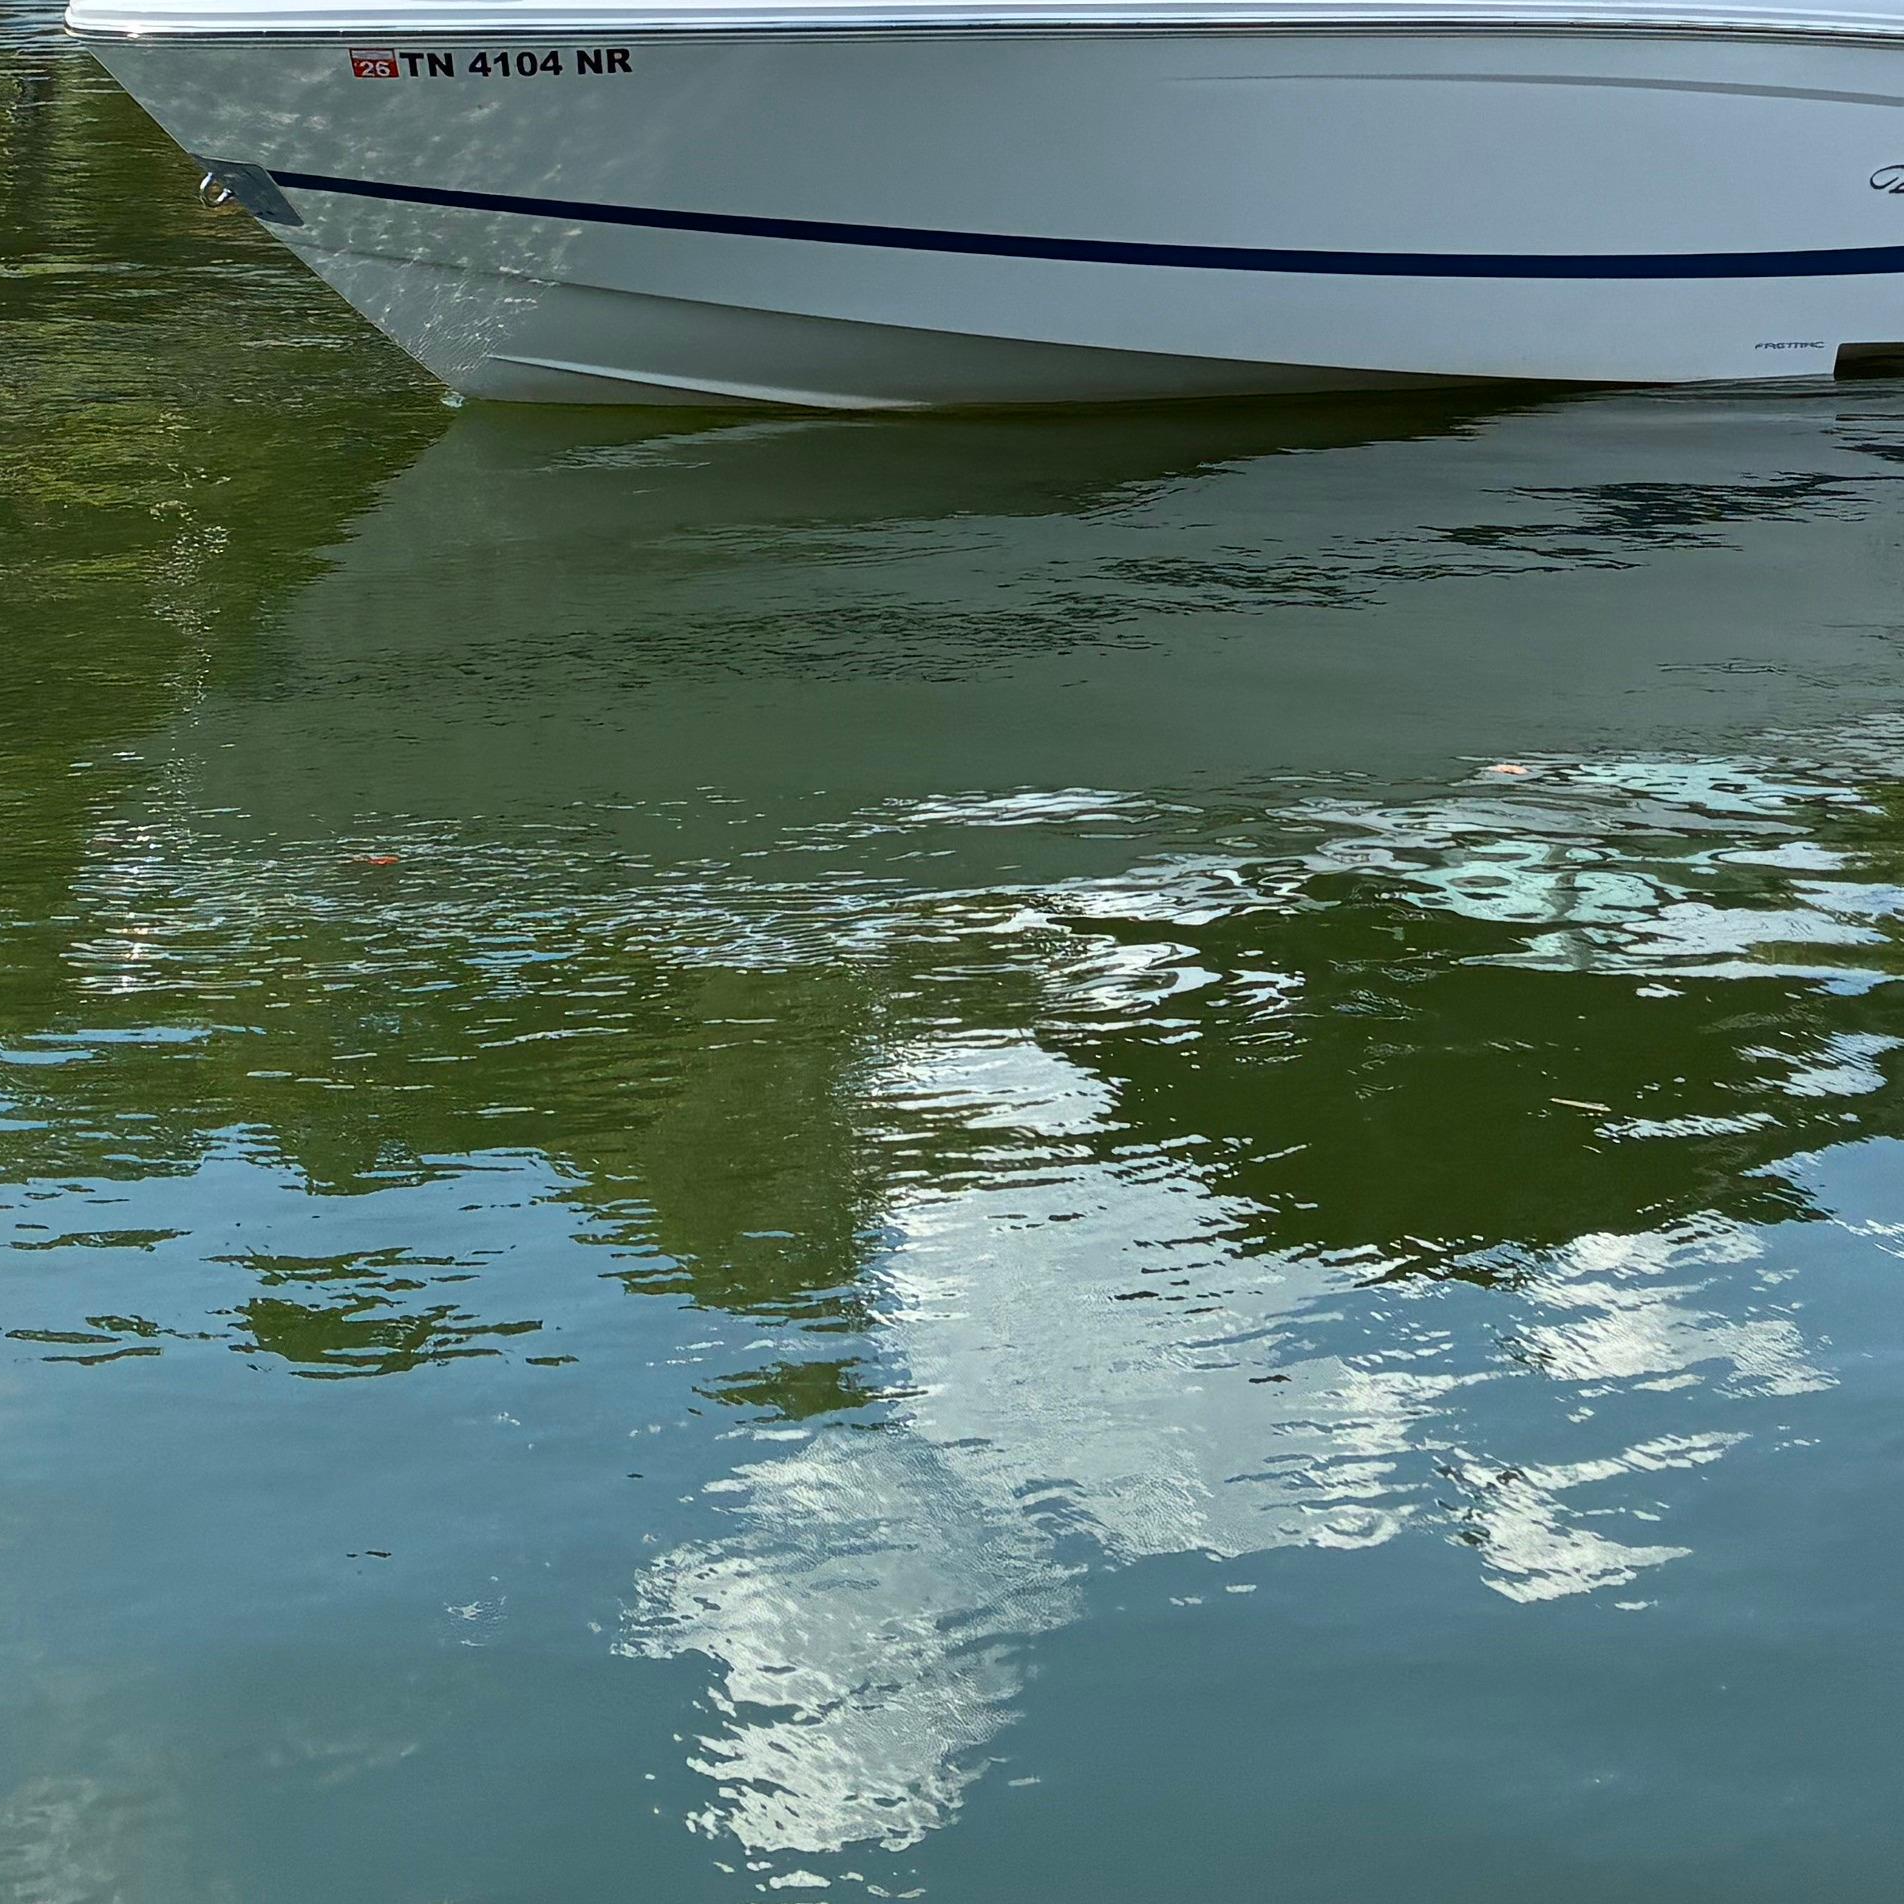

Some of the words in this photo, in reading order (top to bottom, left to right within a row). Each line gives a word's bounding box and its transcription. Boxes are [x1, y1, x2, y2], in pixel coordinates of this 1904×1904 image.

[399, 52, 454, 77] TN
[468, 51, 563, 78] 4104
[576, 48, 633, 75] NR
